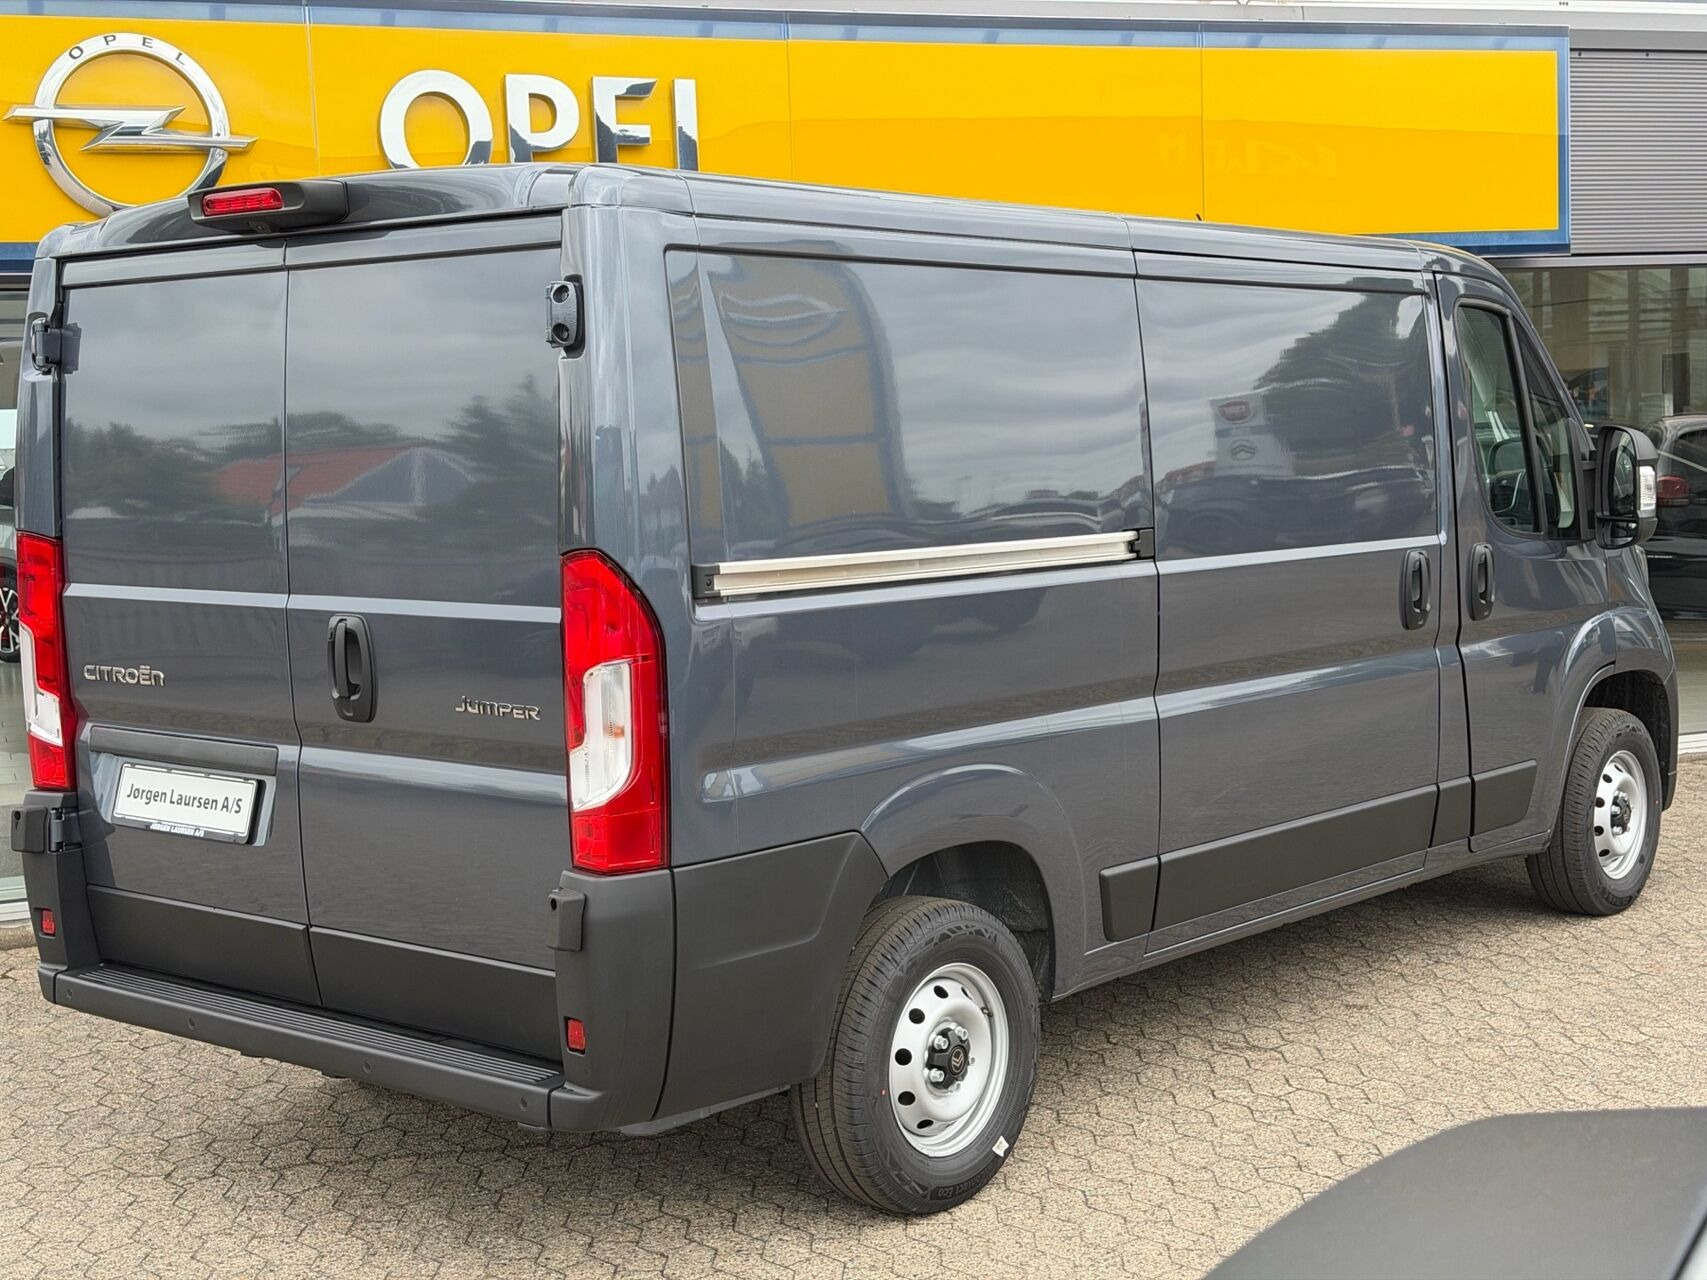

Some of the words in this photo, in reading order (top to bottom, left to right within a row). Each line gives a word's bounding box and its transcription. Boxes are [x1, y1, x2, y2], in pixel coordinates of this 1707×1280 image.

[68, 34, 189, 66] OPEL
[126, 783, 167, 805] Jørgen
[169, 789, 218, 811] Laursen
[220, 796, 243, 814] A/S
